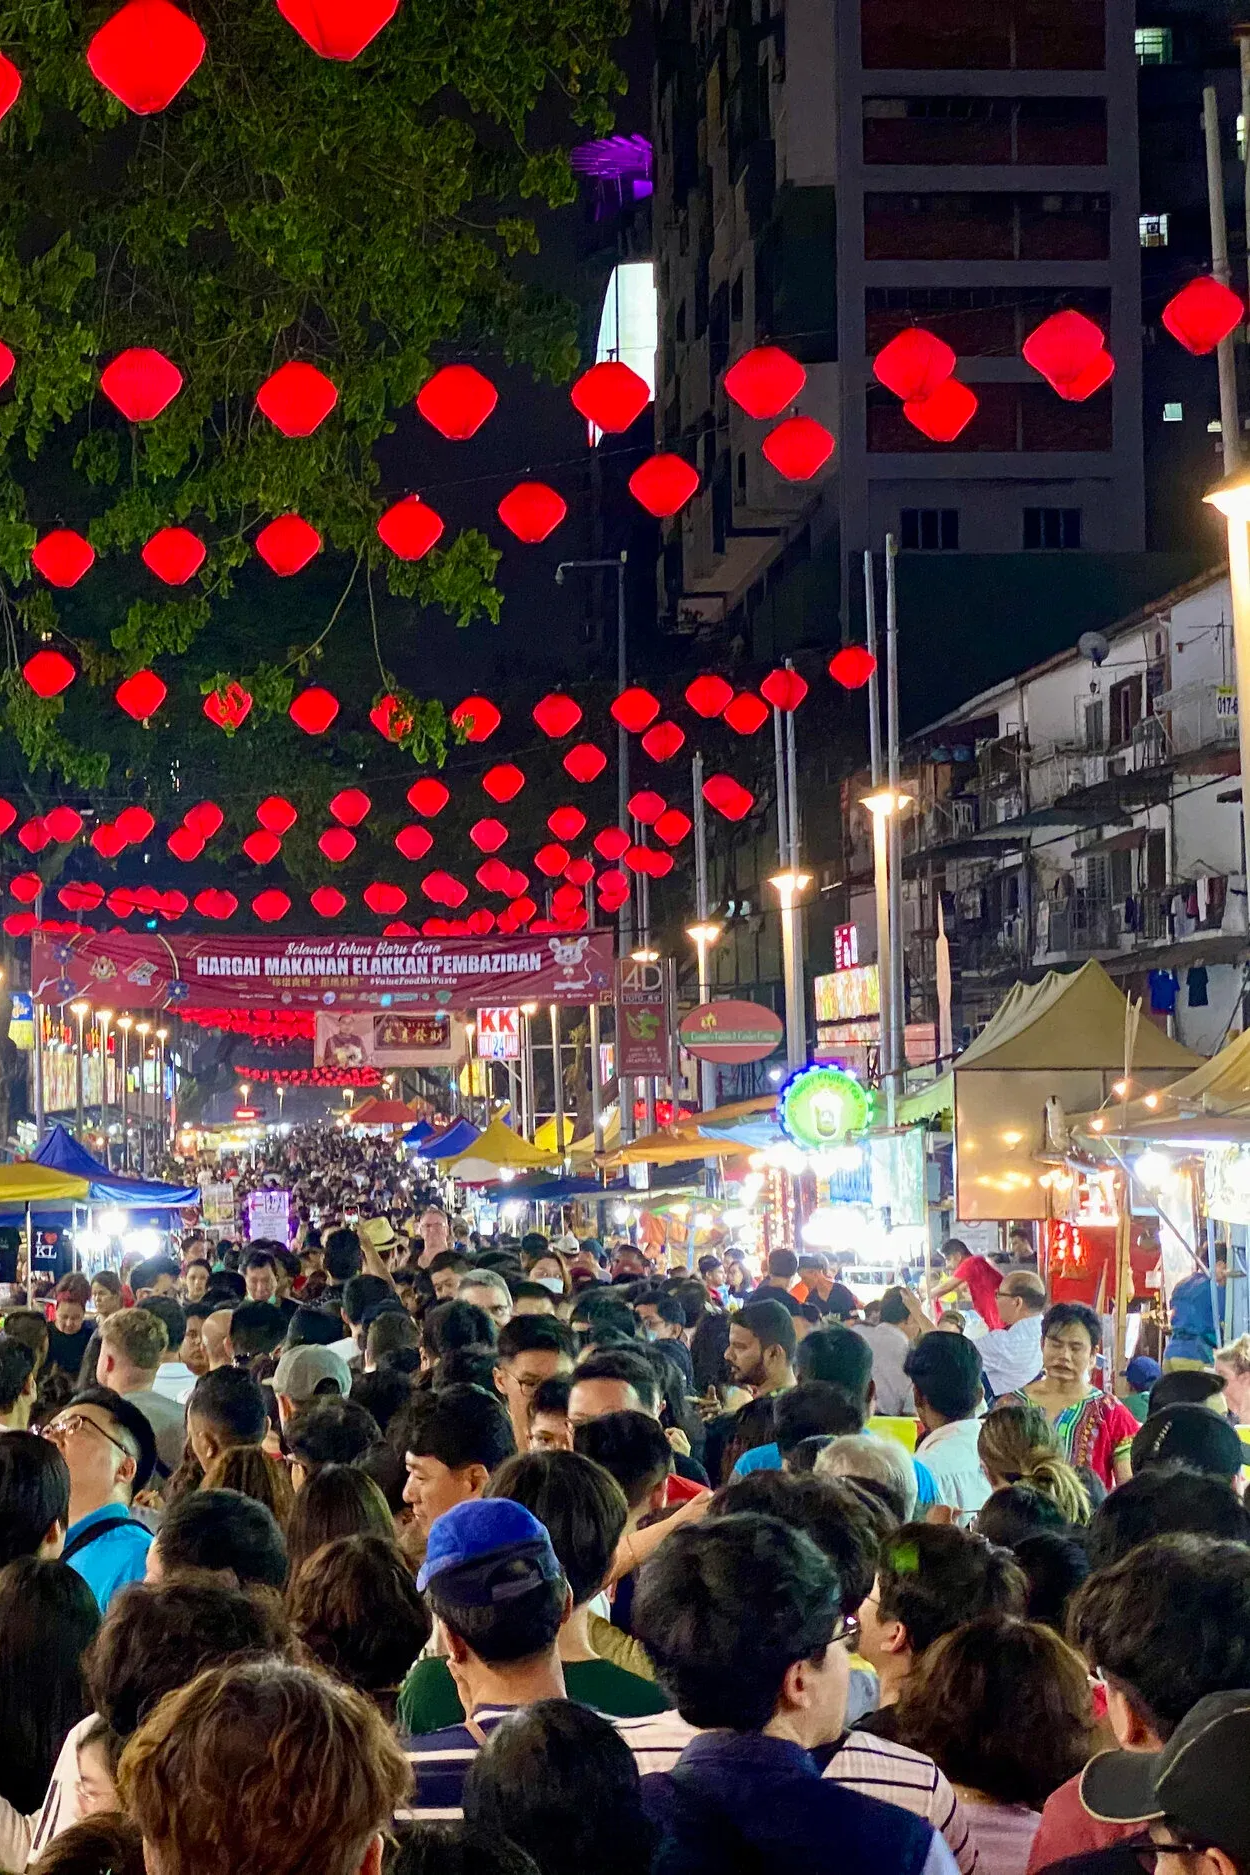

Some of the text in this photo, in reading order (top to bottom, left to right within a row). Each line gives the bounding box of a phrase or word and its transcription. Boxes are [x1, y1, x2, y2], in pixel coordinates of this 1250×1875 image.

[285, 942, 335, 956] Selamat
[337, 942, 372, 956] Tahun
[376, 941, 408, 956] Baru
[197, 952, 542, 976] HARGAI MAKANAN ELAKKAN PEMBAZIRAN
[623, 964, 663, 992] 4D
[481, 1010, 515, 1033] KK
[493, 1036, 504, 1058] 24
[36, 1231, 44, 1245] I
[35, 1245, 57, 1260] KL
